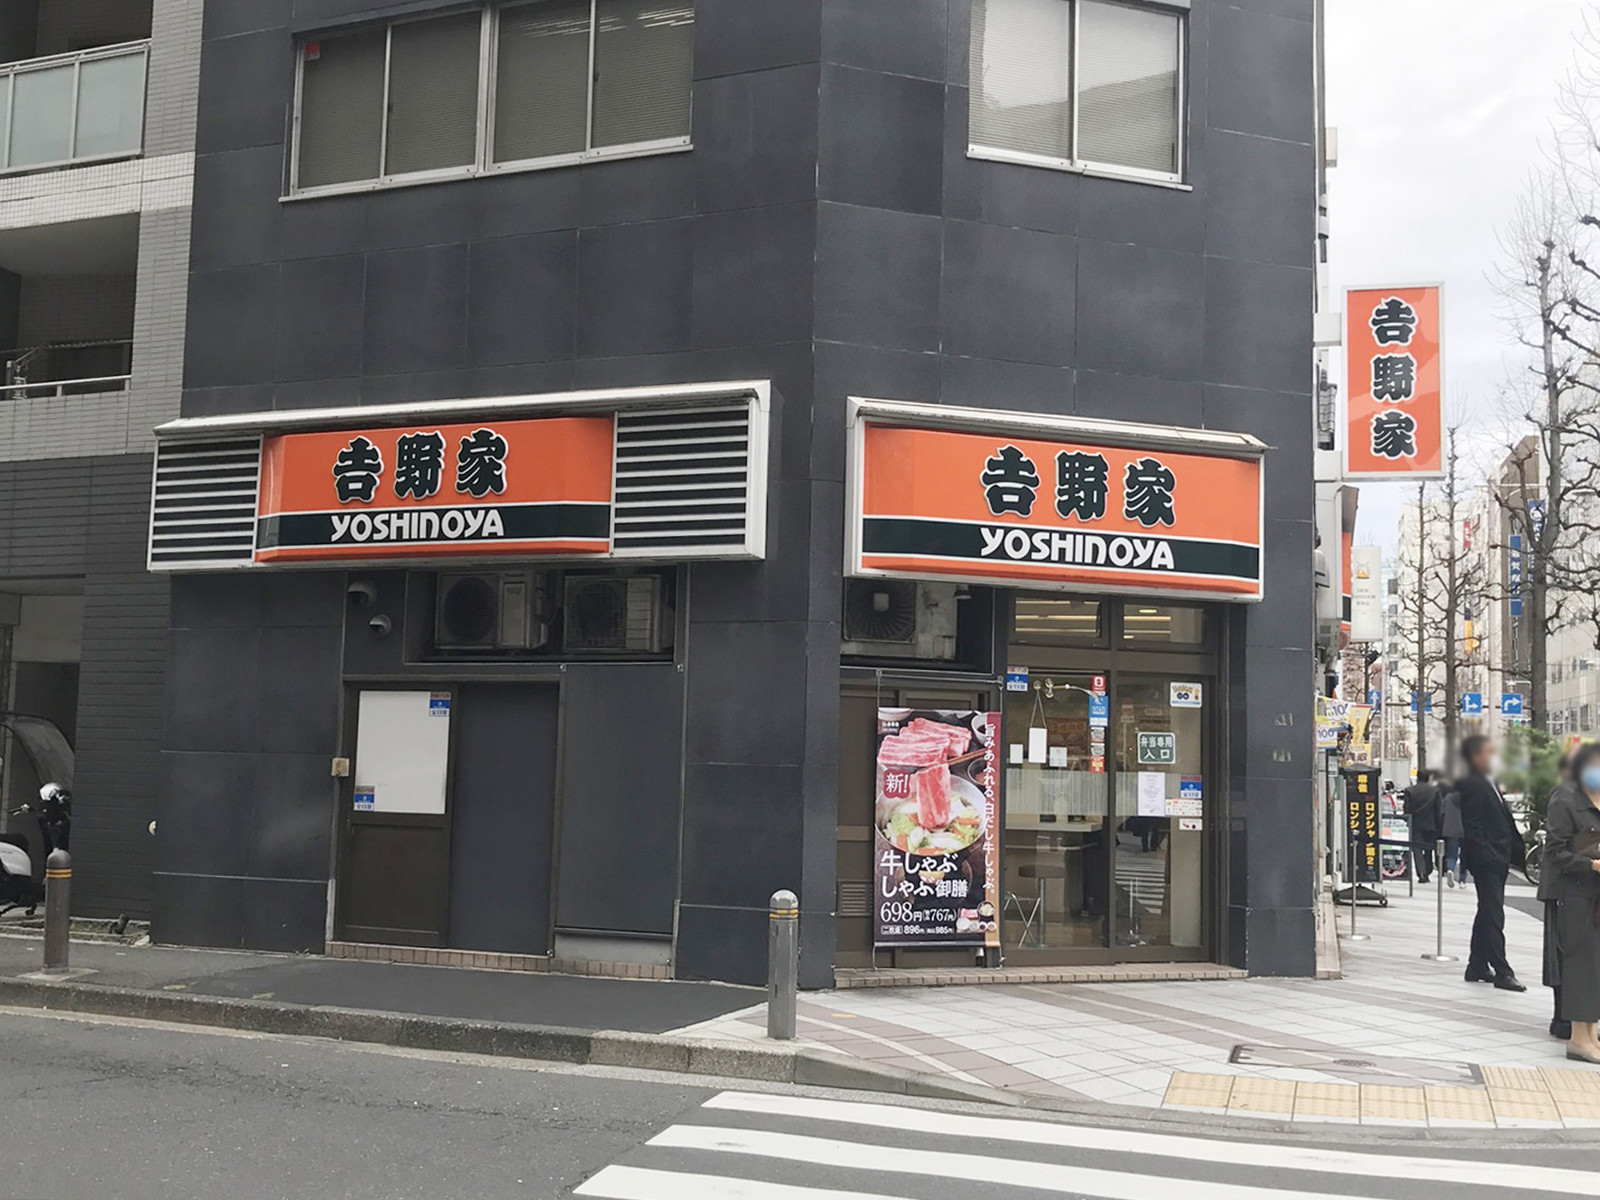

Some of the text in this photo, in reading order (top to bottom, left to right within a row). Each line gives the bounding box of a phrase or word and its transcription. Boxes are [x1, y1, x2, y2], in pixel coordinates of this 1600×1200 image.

[1368, 296, 1418, 460] 吉野家
[332, 427, 509, 504] 吉野家
[980, 444, 1176, 528] 吉野家
[331, 509, 504, 542] YOSHINOYA
[980, 527, 1174, 570] YOSHINOYA
[1141, 736, 1173, 748] 弁当専用
[1144, 748, 1170, 760] 入口
[880, 850, 958, 875] 牛しゃぶ
[882, 875, 968, 898] しゃぶ御膳
